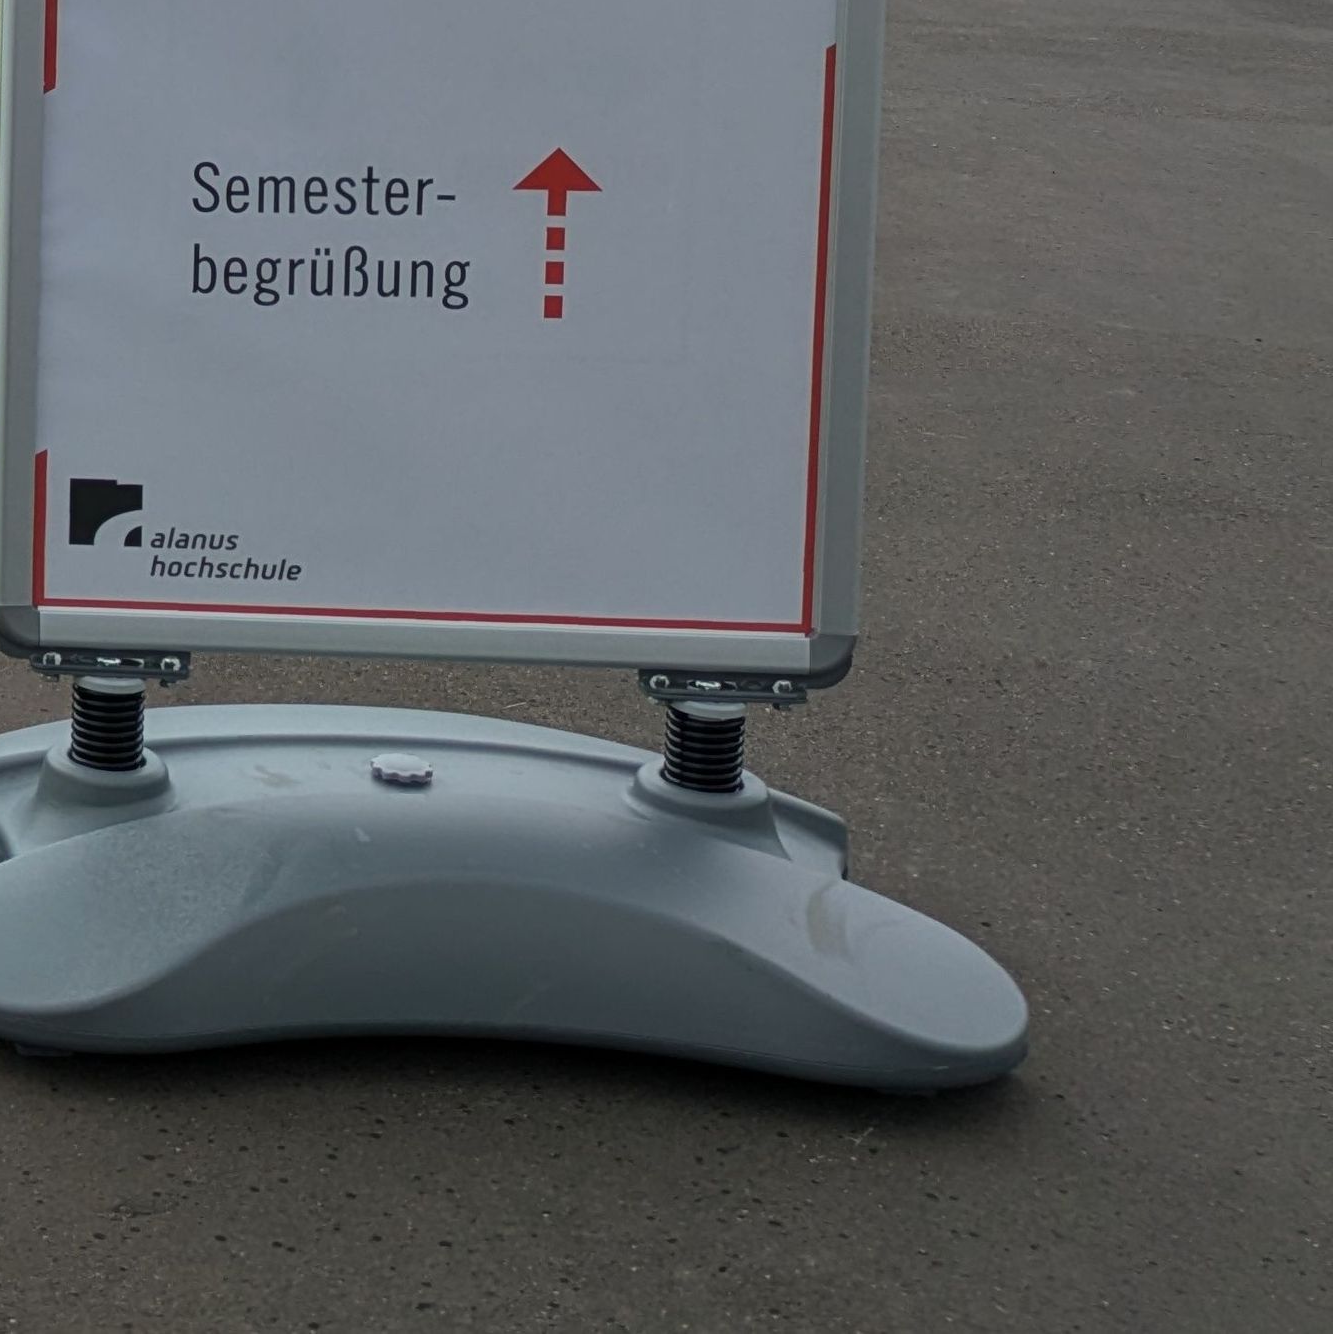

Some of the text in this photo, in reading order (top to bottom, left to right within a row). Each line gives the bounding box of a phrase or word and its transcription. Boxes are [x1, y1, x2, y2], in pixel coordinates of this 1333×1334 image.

[192, 161, 456, 216] Semester-
[192, 243, 470, 310] begrüßung
[150, 527, 239, 551] alanus
[150, 554, 302, 581] hochschule
